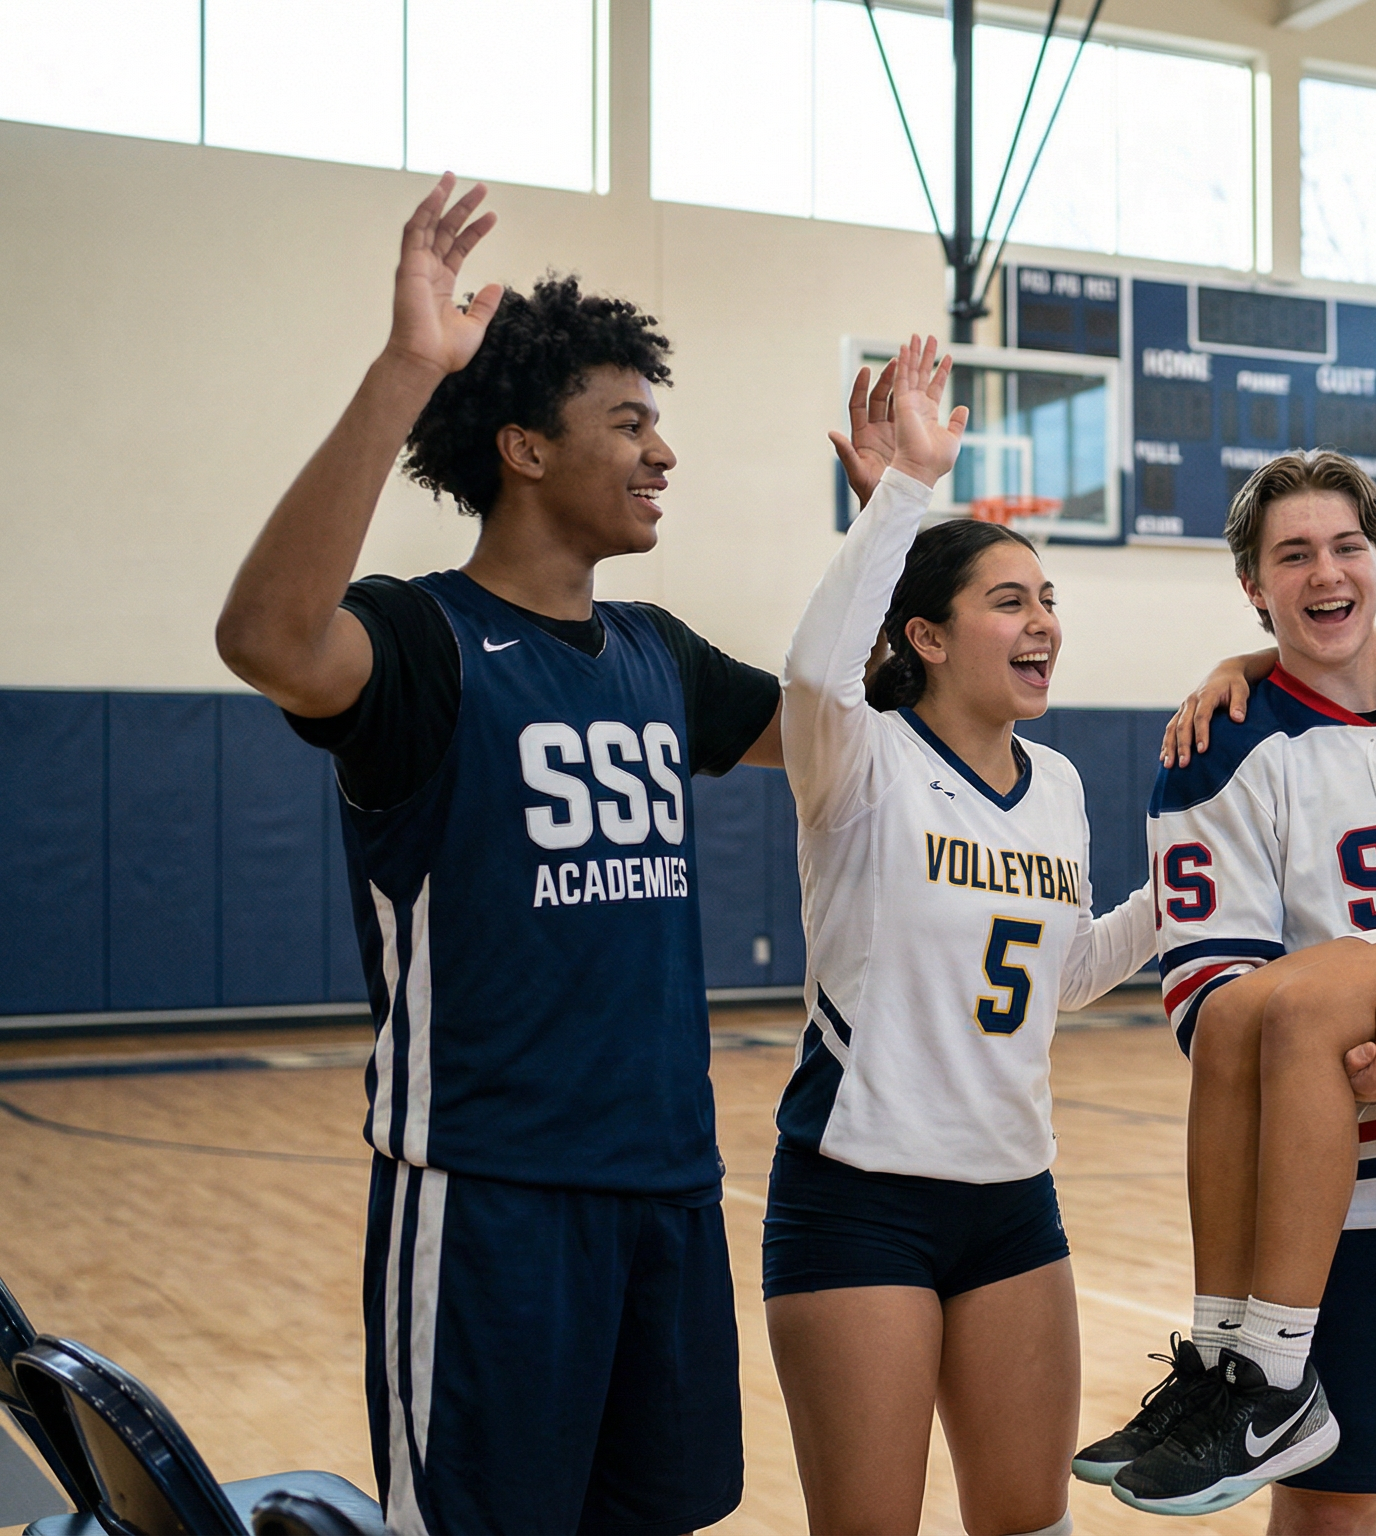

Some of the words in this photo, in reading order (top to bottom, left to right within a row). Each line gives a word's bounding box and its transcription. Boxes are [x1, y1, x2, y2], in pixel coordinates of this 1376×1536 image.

[518, 721, 685, 850] SSS
[533, 856, 688, 907] ACADEMIES
[1153, 841, 1217, 931] S
[974, 914, 1045, 1038] 5
